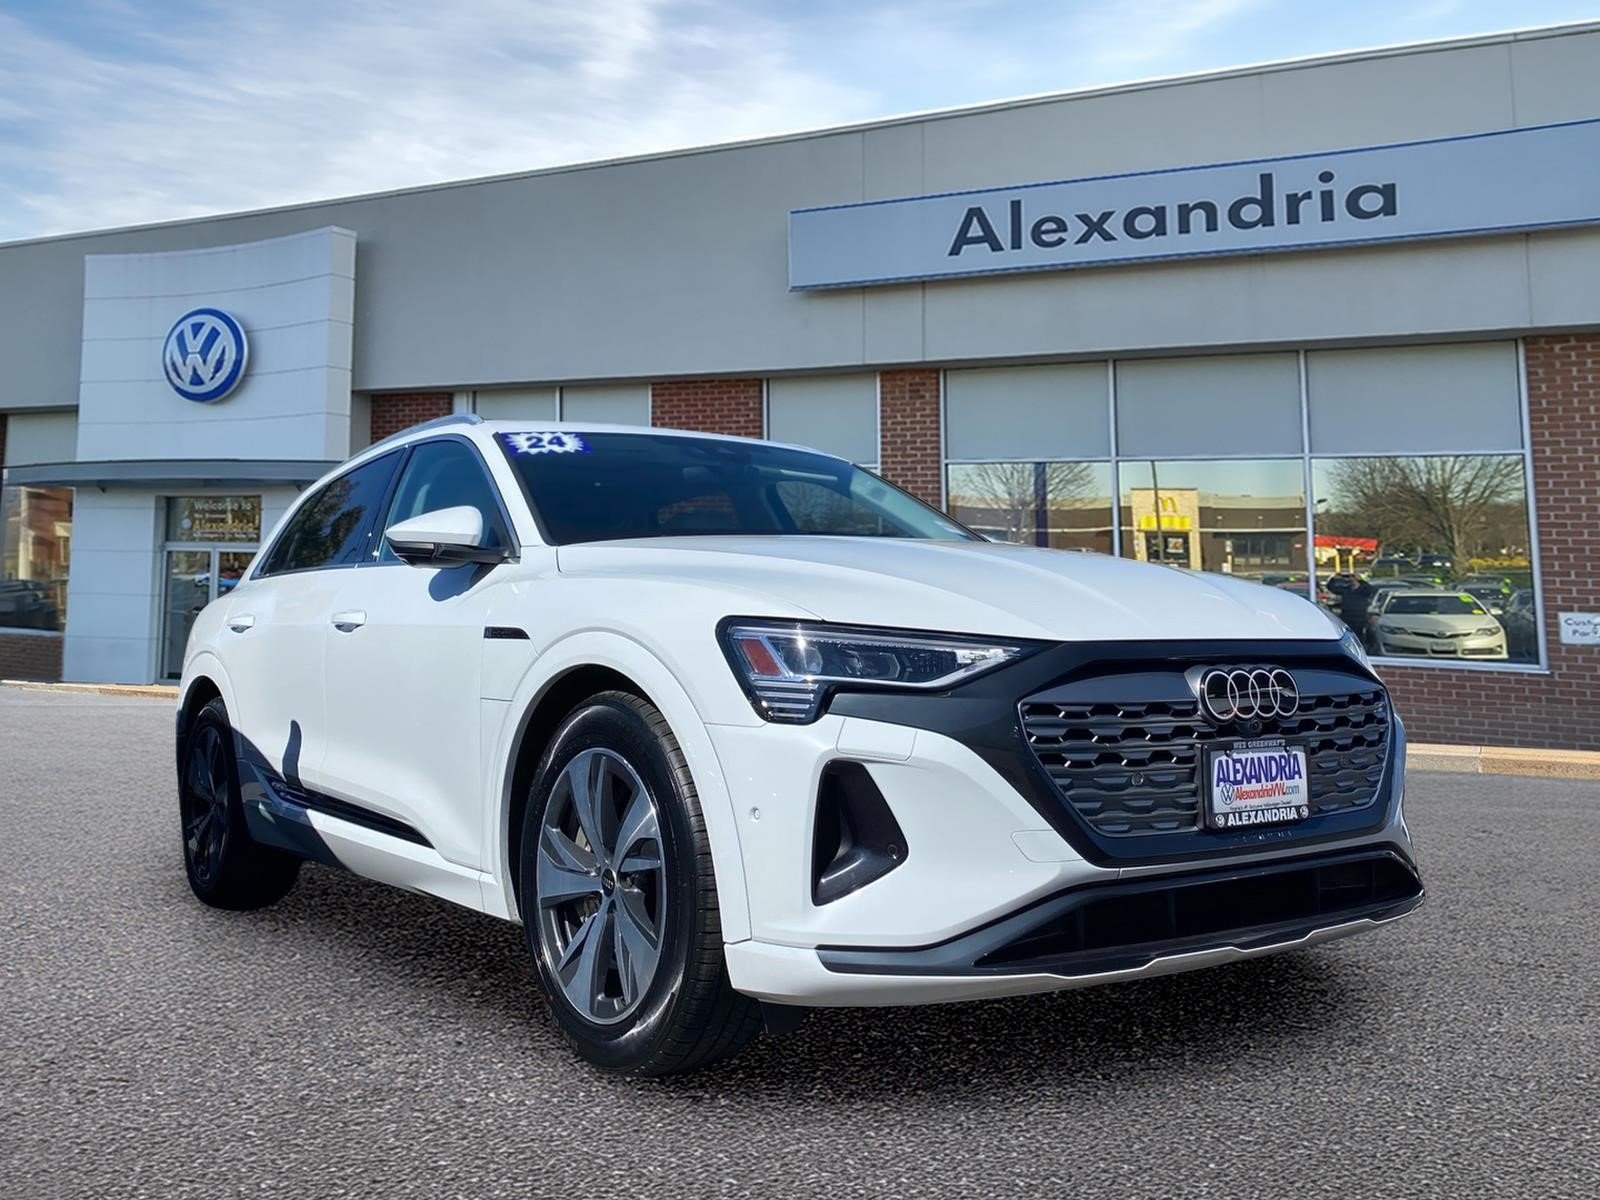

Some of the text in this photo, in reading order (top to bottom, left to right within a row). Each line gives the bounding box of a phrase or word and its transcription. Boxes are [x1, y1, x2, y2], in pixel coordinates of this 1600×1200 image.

[947, 170, 1397, 257] Alexandria
[525, 435, 567, 449] 24
[194, 500, 252, 510] Welcome to
[1216, 754, 1302, 787] ALEXANDRIA
[1235, 784, 1299, 800] AlexandriaVW.com
[1228, 808, 1298, 826] ALEXANDRIA
